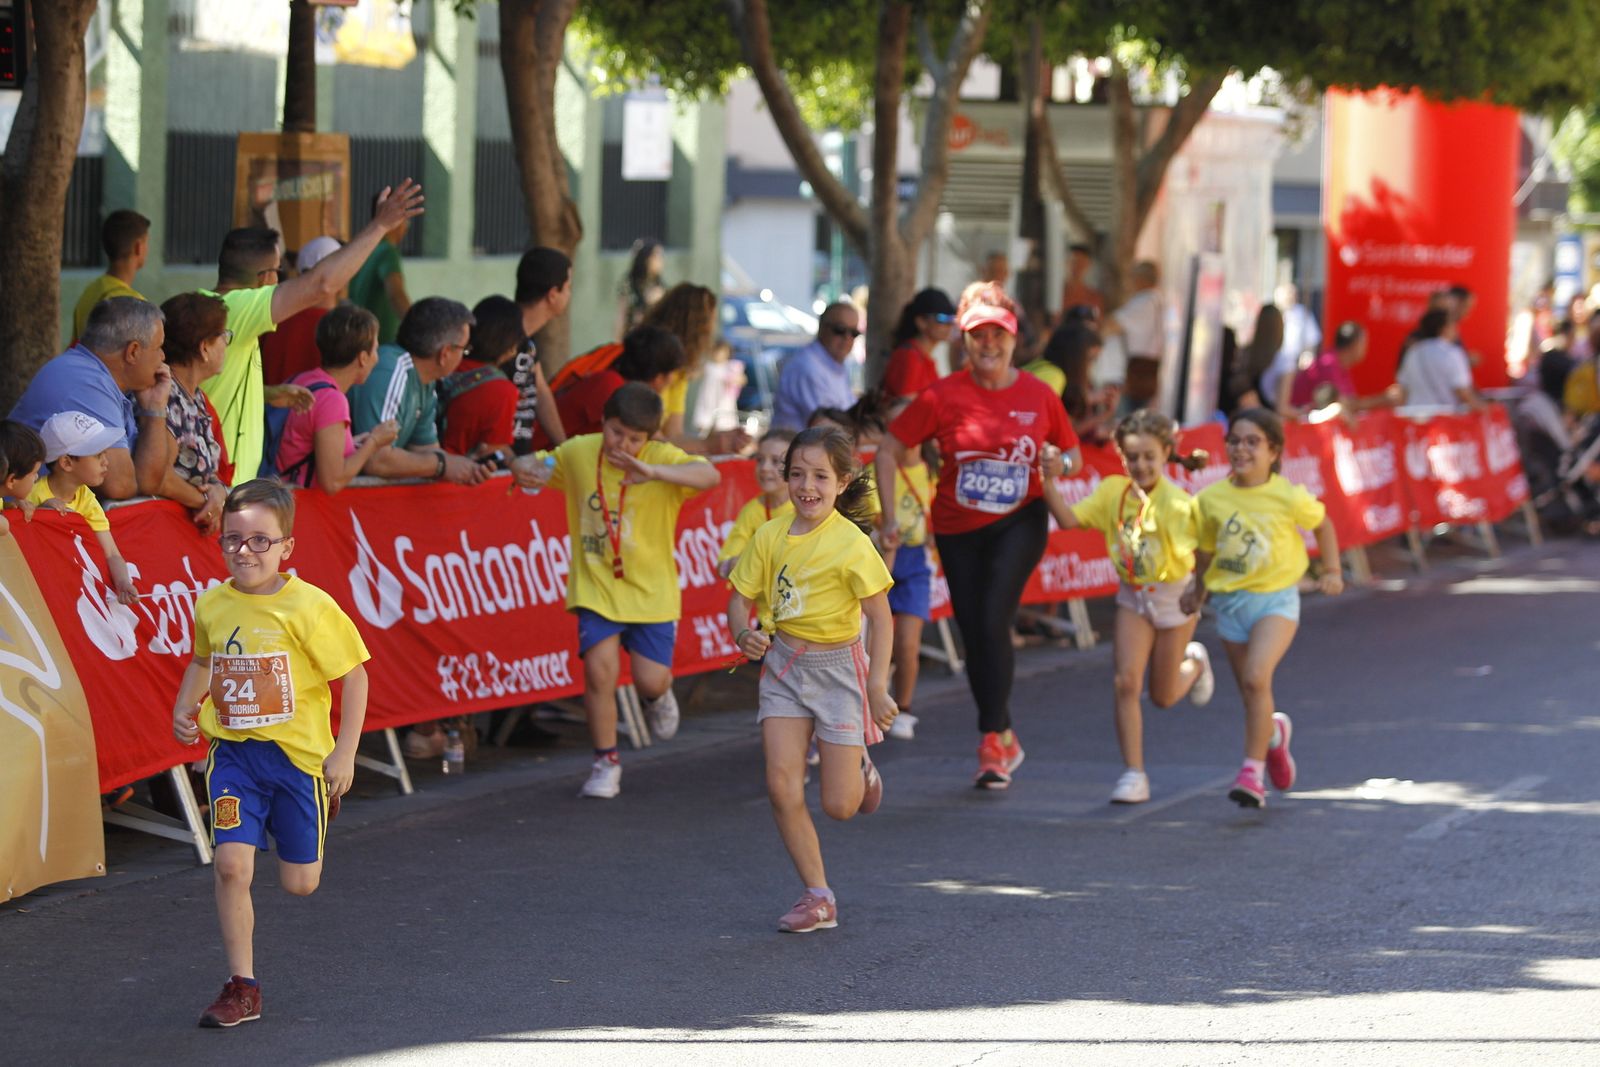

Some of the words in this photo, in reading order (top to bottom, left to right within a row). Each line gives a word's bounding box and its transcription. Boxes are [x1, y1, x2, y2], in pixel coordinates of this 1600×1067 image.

[963, 473, 1015, 496] 2026
[222, 678, 256, 702] 24
[229, 703, 260, 715] RODRIGO
